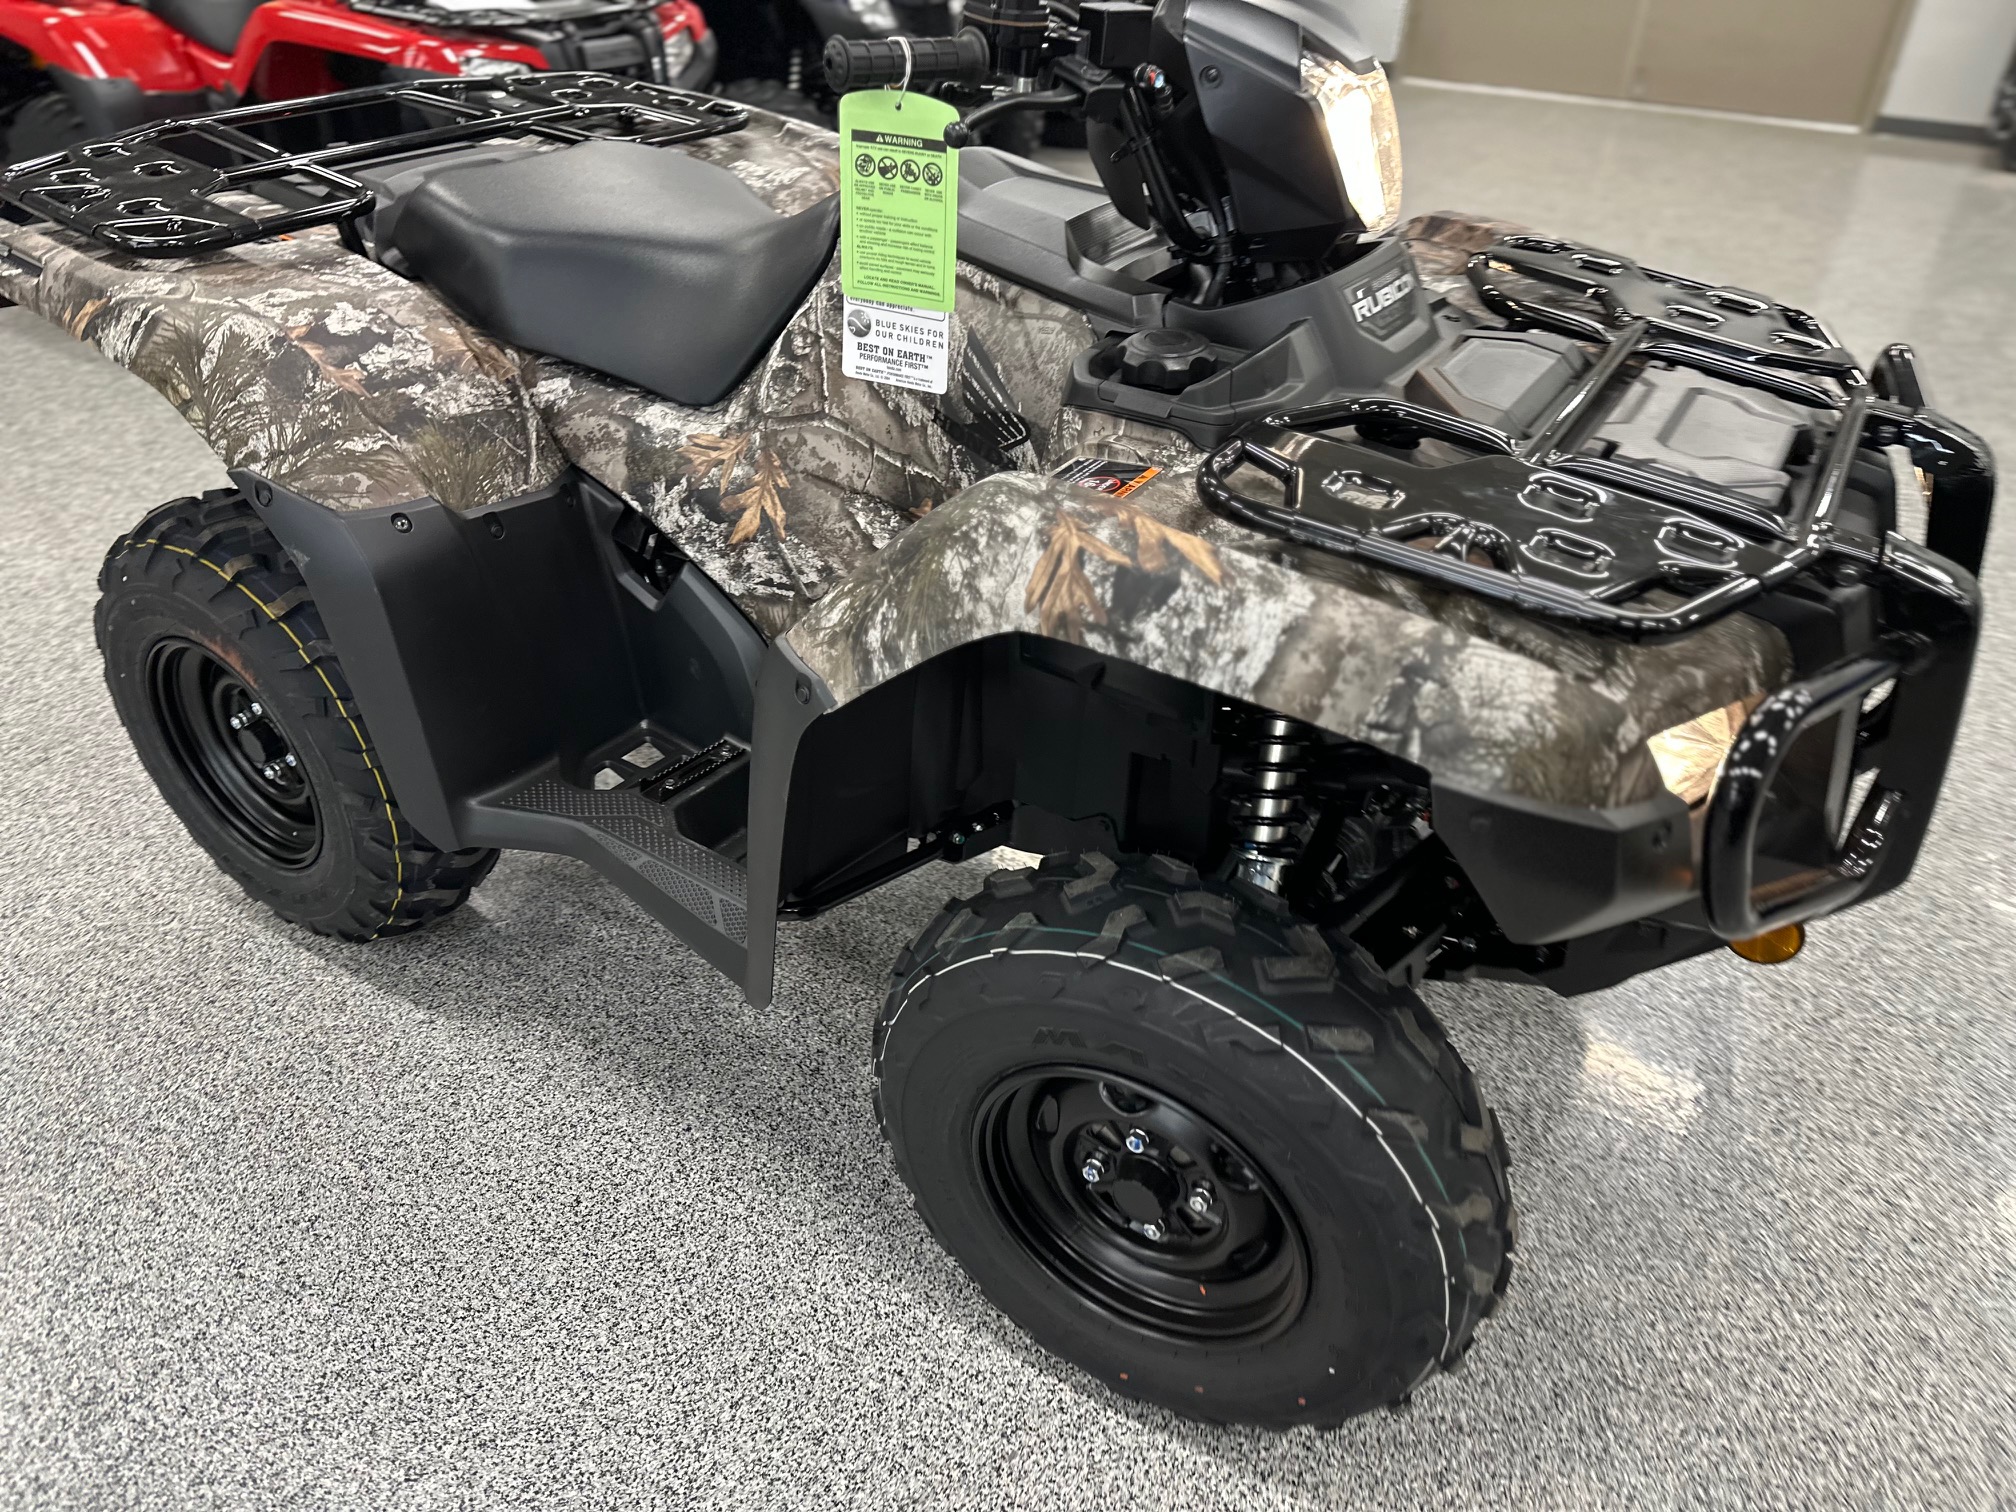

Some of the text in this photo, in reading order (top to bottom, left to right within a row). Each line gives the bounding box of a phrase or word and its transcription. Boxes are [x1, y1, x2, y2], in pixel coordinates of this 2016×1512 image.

[884, 134, 923, 148] WARNING
[1351, 273, 1415, 323] RUBICO
[876, 319, 943, 339] BLUE SKIES FOR
[876, 329, 944, 349] OUR CHILDREN
[857, 342, 880, 354] BEST
[883, 347, 894, 356] ON
[859, 353, 903, 367] PERFORMANCE
